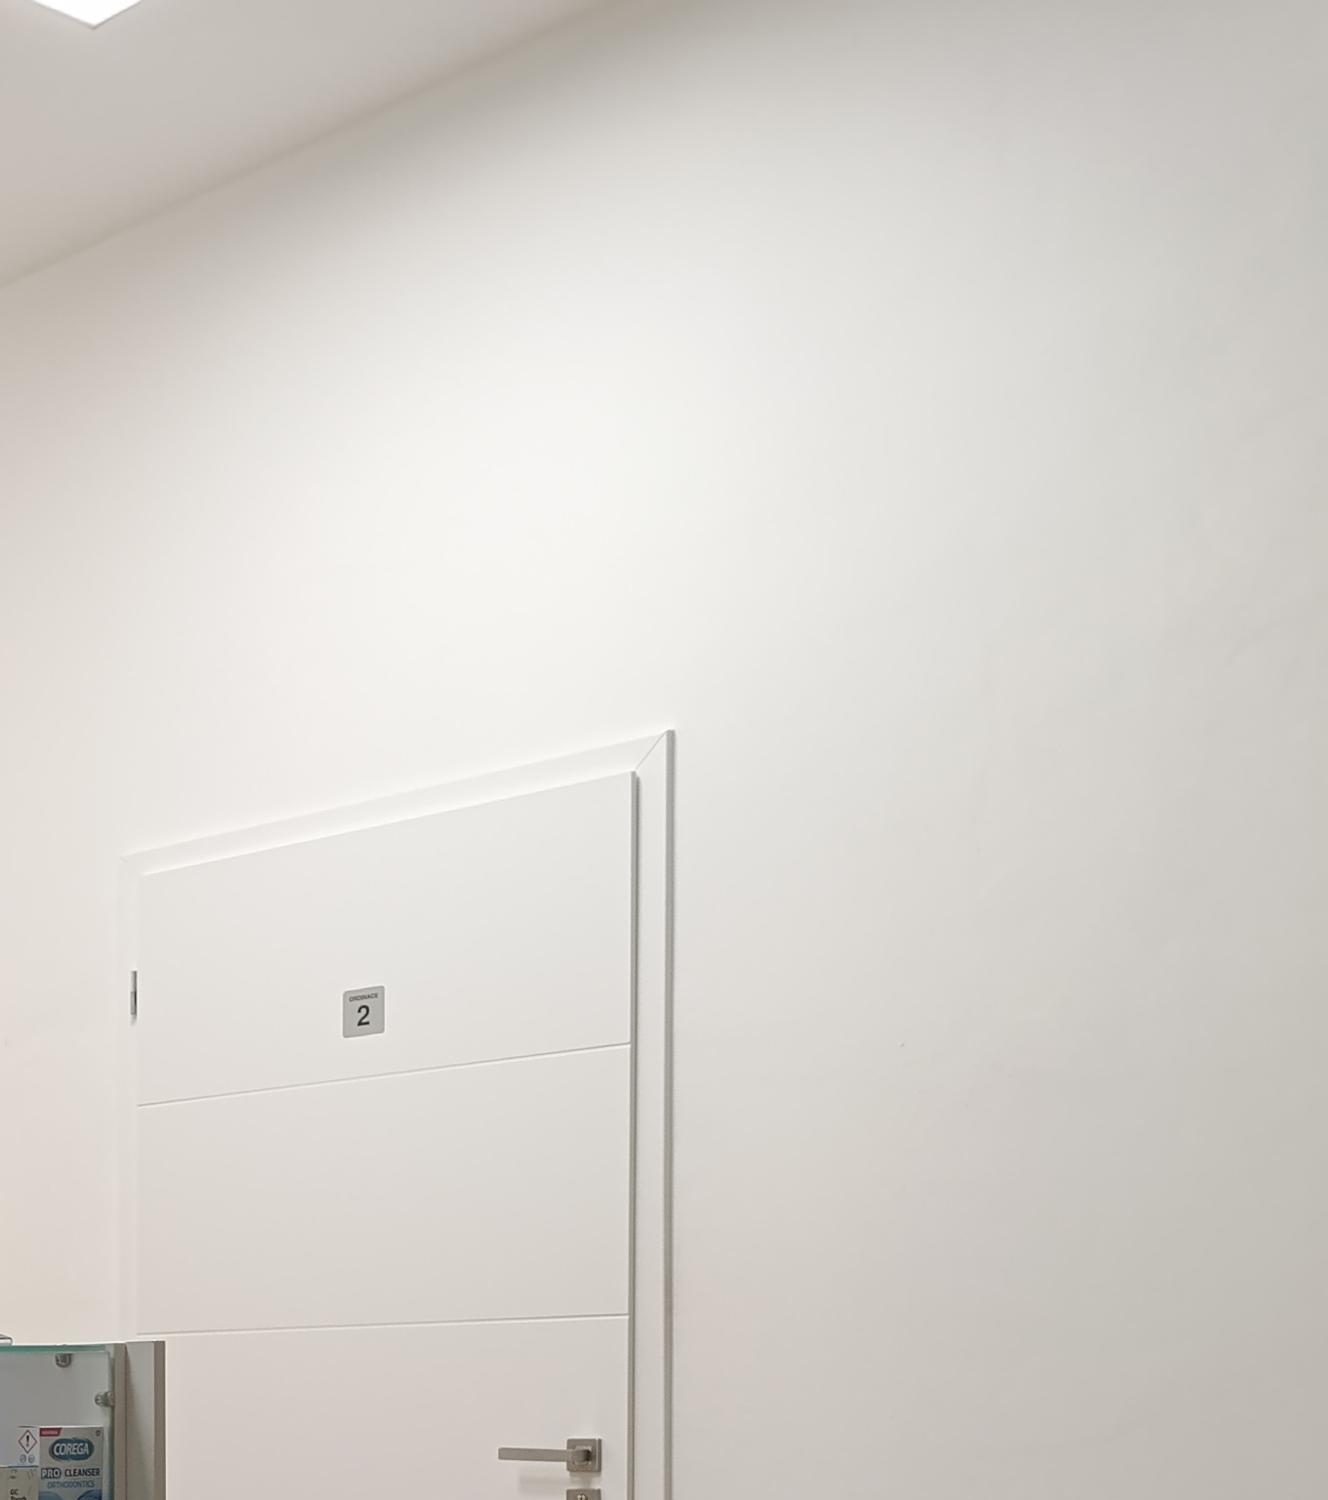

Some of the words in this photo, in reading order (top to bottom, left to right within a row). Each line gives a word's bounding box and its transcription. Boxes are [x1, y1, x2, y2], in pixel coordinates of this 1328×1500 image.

[357, 1004, 370, 1026] 2
[53, 1442, 90, 1456] COREGA
[41, 1468, 62, 1479] PRO
[64, 1467, 101, 1478] CLEANSER
[47, 1480, 96, 1489] ORTHODONTICS
